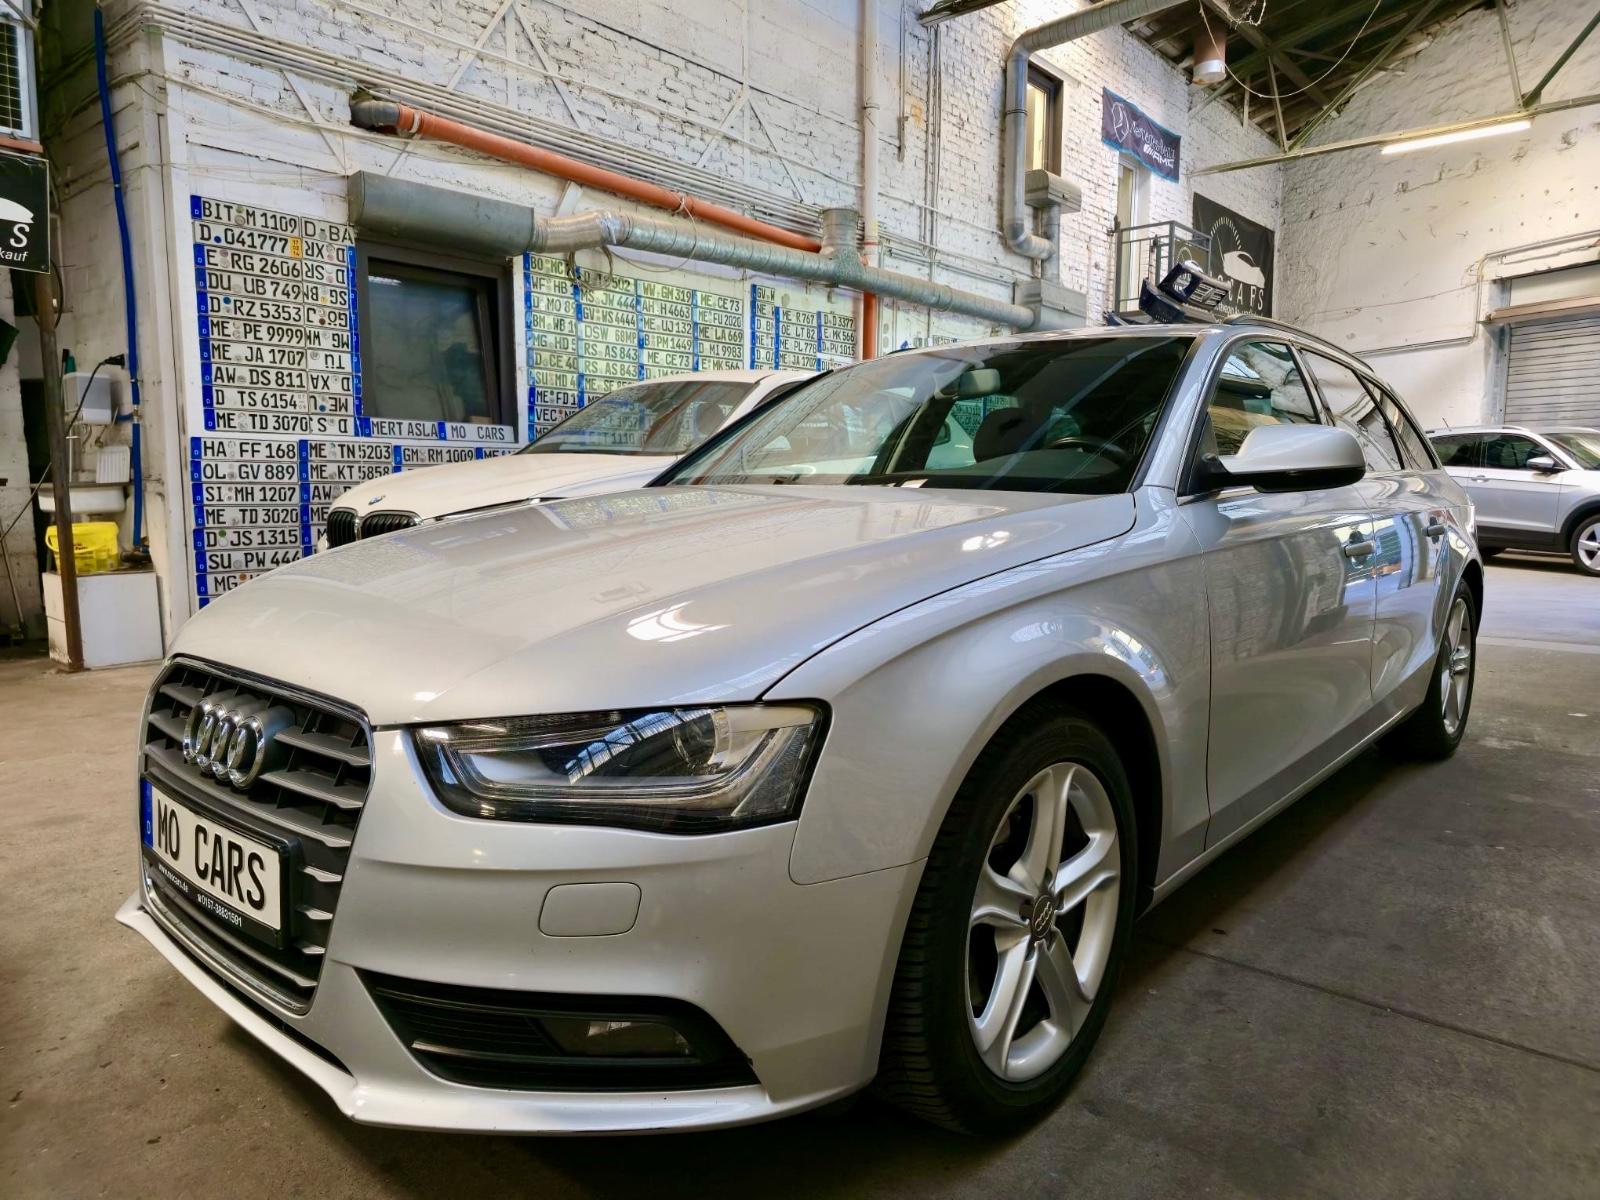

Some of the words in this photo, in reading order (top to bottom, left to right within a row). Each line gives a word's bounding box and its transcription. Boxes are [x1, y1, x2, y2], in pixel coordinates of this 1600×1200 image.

[203, 200, 233, 222] BIT
[246, 209, 256, 226] M
[261, 213, 297, 233] 1109
[10, 224, 30, 247] S
[200, 224, 211, 241] D
[206, 249, 218, 266] E
[231, 253, 254, 271] RG
[260, 258, 300, 277] 2606
[531, 256, 543, 270] BO
[208, 273, 231, 291] DU
[244, 278, 266, 295] UB
[271, 282, 301, 299] 749
[532, 276, 545, 290] WF
[554, 280, 567, 294] HB
[662, 286, 673, 300] GM
[675, 289, 691, 303] 319
[210, 296, 220, 312] D
[234, 300, 256, 317] RZ
[260, 304, 301, 322] 5353
[547, 298, 561, 311] MO
[617, 296, 635, 310] 444
[643, 301, 654, 313] AH
[661, 303, 666, 315] H
[669, 306, 690, 319] 4663
[701, 294, 712, 307] ME
[718, 297, 728, 309] CE
[730, 300, 739, 312] 73
[584, 307, 595, 320] GV
[616, 313, 635, 327] 4444
[714, 313, 722, 324] FU
[725, 315, 741, 328] 2020
[803, 313, 814, 324] 767
[210, 321, 231, 337] ME
[244, 323, 263, 341] PE
[267, 326, 303, 344] 9999
[585, 325, 608, 340] DSW
[644, 318, 655, 330] ME
[662, 320, 673, 333] UJ
[676, 322, 691, 335] 132
[699, 326, 709, 338] ME
[715, 328, 726, 341] LA
[728, 330, 742, 342] 669
[332, 334, 349, 349] MG
[645, 334, 649, 346] B
[657, 337, 668, 348] PM
[671, 338, 692, 350] 1449
[211, 343, 231, 360] ME
[245, 347, 264, 362] JA
[269, 349, 304, 366] 1707
[585, 343, 597, 356] RS
[605, 345, 617, 358] AS
[620, 347, 637, 360] 843
[710, 344, 719, 355] MI
[722, 346, 741, 358] 9983
[325, 354, 345, 370] TÜ
[648, 352, 659, 364] ME
[666, 354, 677, 365] CE
[679, 355, 689, 367] 73
[585, 361, 597, 373] RS
[606, 363, 617, 375] AS
[620, 364, 637, 377] 843
[214, 367, 236, 384] AW
[250, 369, 270, 386] DS
[276, 371, 305, 388] 811
[311, 375, 330, 390] XA
[342, 377, 350, 391] D
[536, 371, 547, 385] SU
[555, 373, 567, 387] MD
[216, 390, 224, 405] D
[238, 391, 256, 407] TS
[262, 393, 297, 409] 6154
[328, 397, 348, 412] ME
[537, 390, 548, 403] ME
[557, 392, 568, 404] FD
[216, 413, 236, 429] ME
[249, 414, 268, 430] TD
[273, 416, 308, 432] 3070
[536, 408, 557, 421] VEC
[372, 423, 402, 436] MERT
[408, 424, 438, 437] ASLA
[452, 426, 465, 438] MO
[478, 426, 504, 440] CARS
[204, 441, 226, 456] HA
[240, 442, 261, 458] FF
[265, 444, 296, 459] 168
[310, 444, 327, 458] ME
[338, 444, 355, 459] TN
[359, 445, 390, 460] 5203
[404, 448, 419, 462] GM
[428, 449, 442, 462] RM
[446, 450, 473, 462] 1009
[204, 464, 226, 479] OL
[238, 464, 260, 479] GV
[265, 465, 295, 480] 889
[311, 465, 328, 479] ME
[338, 465, 354, 479] KT
[359, 467, 390, 480] 5858
[206, 487, 224, 502] SI
[235, 487, 254, 502] MH
[260, 487, 296, 502] 1207
[312, 486, 331, 500] AW
[206, 509, 226, 524] ME
[239, 509, 258, 524] TD
[263, 509, 298, 523] 3020
[206, 532, 217, 547] D
[231, 531, 252, 546] JS
[258, 529, 298, 545] 1315
[209, 554, 231, 569] SU
[244, 552, 265, 568] PW
[215, 576, 237, 592] MG
[158, 798, 180, 861] MO
[194, 824, 264, 910] CARS
